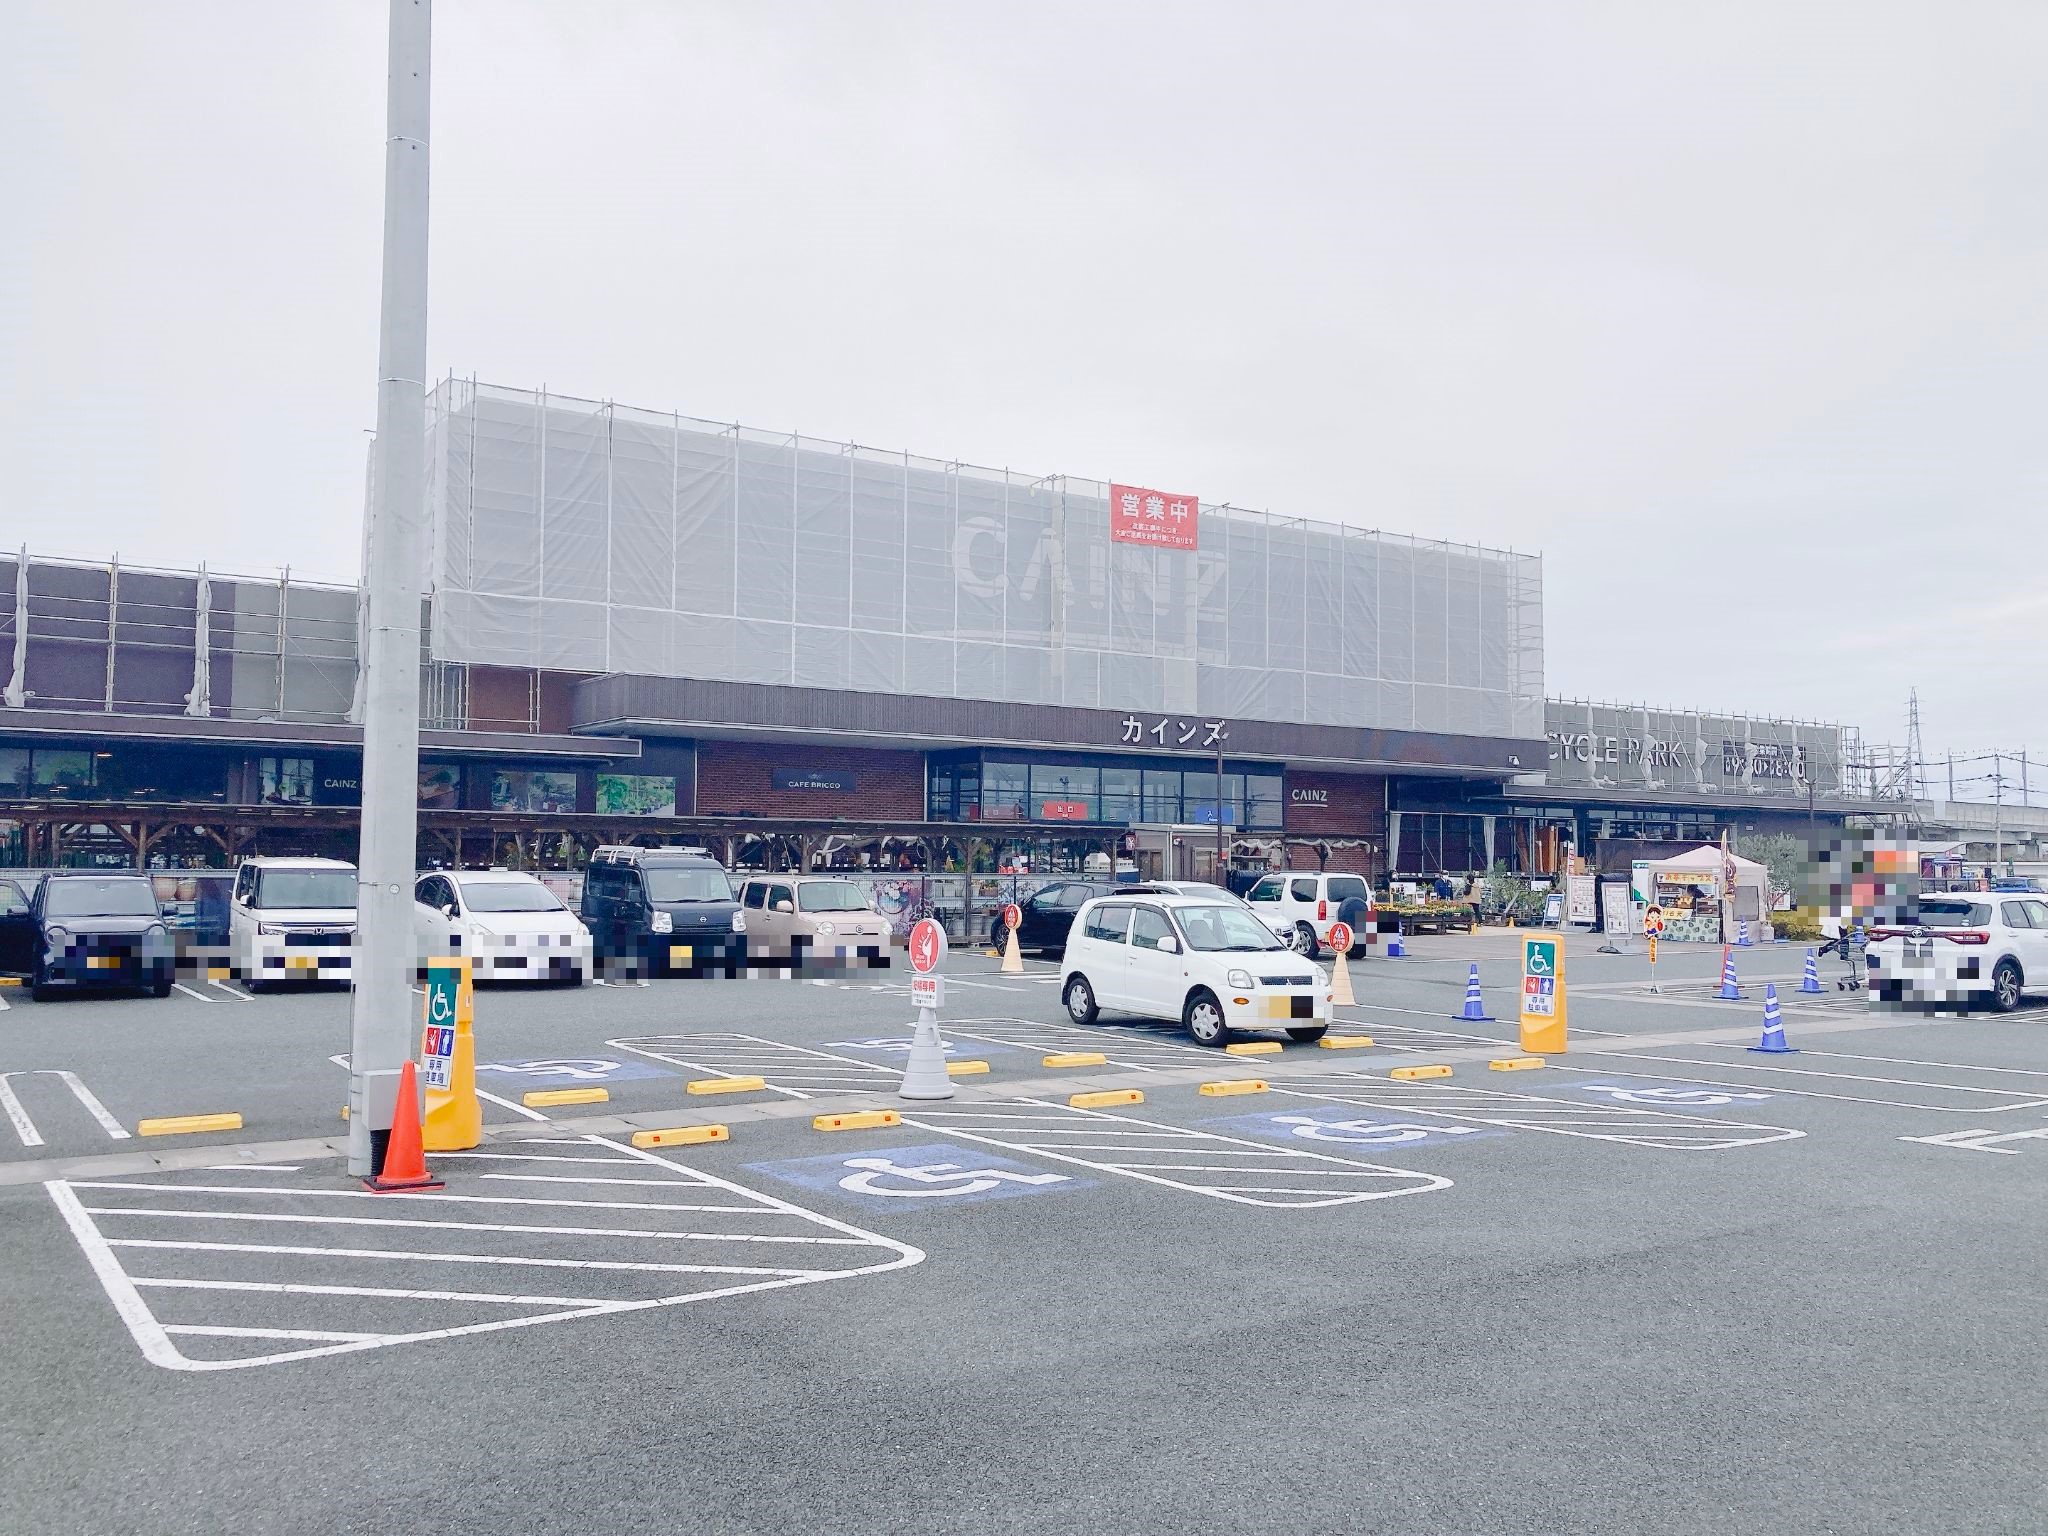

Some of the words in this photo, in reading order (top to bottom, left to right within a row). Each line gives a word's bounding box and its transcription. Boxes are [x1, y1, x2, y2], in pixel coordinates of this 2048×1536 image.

[1121, 493, 1188, 523] 営業中
[951, 516, 1227, 623] CAINZ
[1122, 716, 1226, 747] カインズ
[324, 779, 357, 789] CAINZ
[1292, 789, 1328, 802] CAINZ
